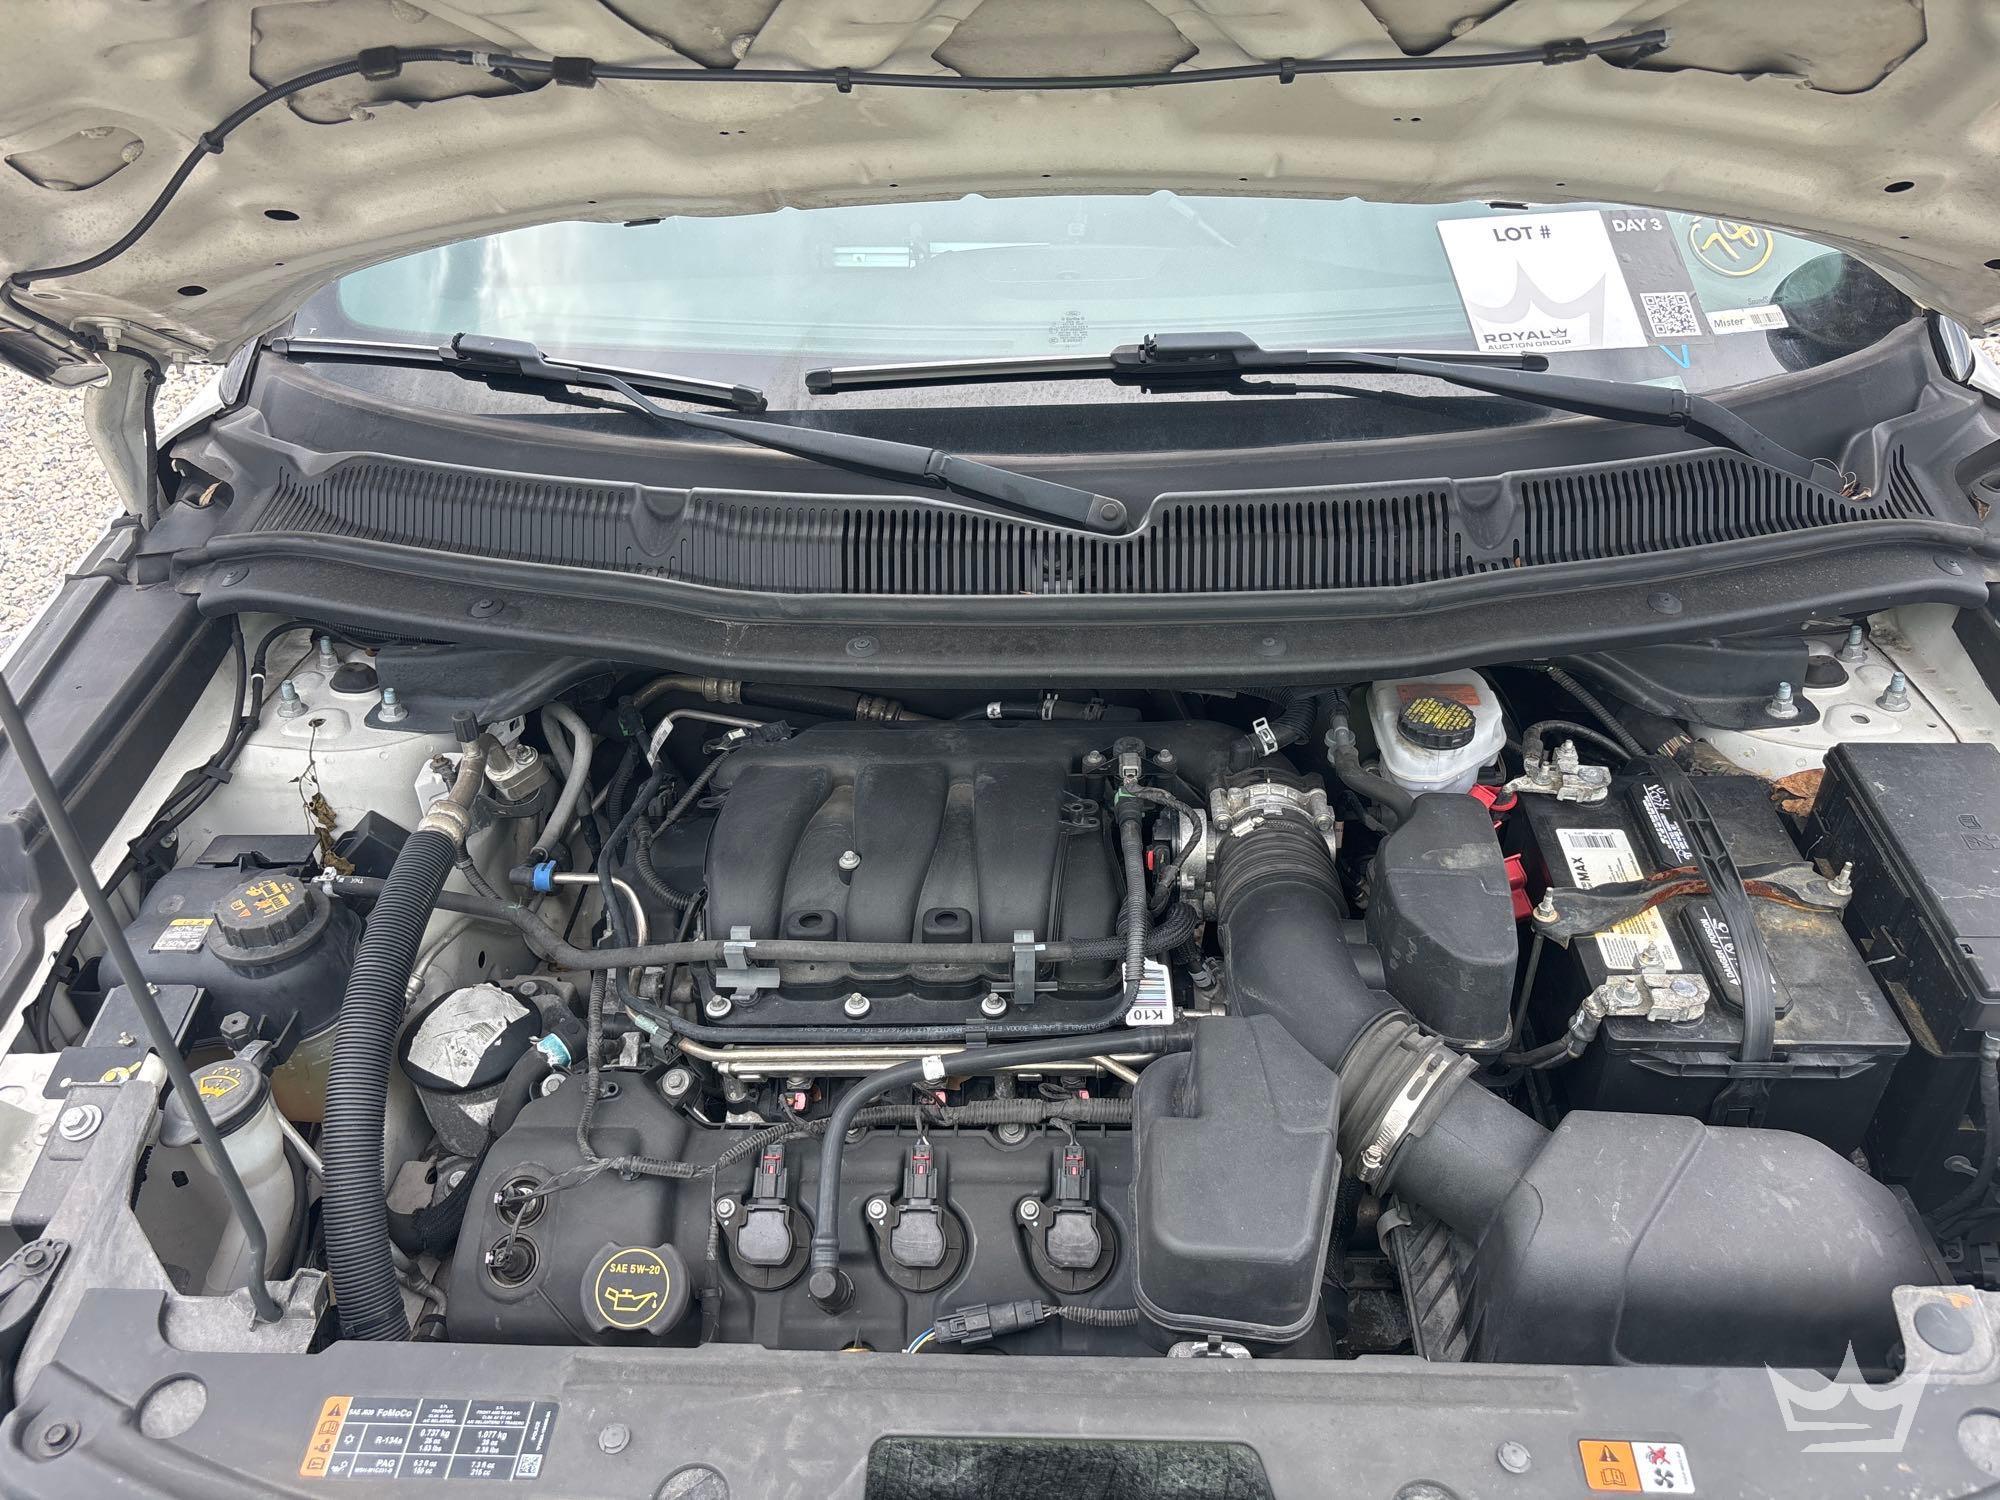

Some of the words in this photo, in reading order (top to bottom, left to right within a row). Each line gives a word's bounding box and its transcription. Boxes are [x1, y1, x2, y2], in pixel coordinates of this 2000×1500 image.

[1611, 218, 1647, 232] DAY
[1649, 217, 1663, 231] 3
[1492, 226, 1533, 242] LOT
[1539, 225, 1552, 239] #
[1713, 318, 1746, 329] Mister
[1483, 328, 1552, 344] ROYAL
[1487, 341, 1534, 351] AUCTION
[1535, 339, 1572, 348] GROUP
[1571, 857, 1591, 881] MAX
[1700, 918, 1719, 944] POISON
[1715, 949, 1736, 978] DANGER
[1133, 1009, 1163, 1021] K10
[609, 1263, 628, 1273] SAE
[629, 1264, 661, 1275] 5W-20
[376, 1408, 413, 1417] FoMoCo
[375, 1435, 403, 1444] R-134a
[420, 1428, 440, 1437] 0.737
[440, 1429, 451, 1439] kg
[477, 1430, 497, 1439] 1.077
[497, 1431, 508, 1441] kg
[376, 1459, 396, 1468] PAG
